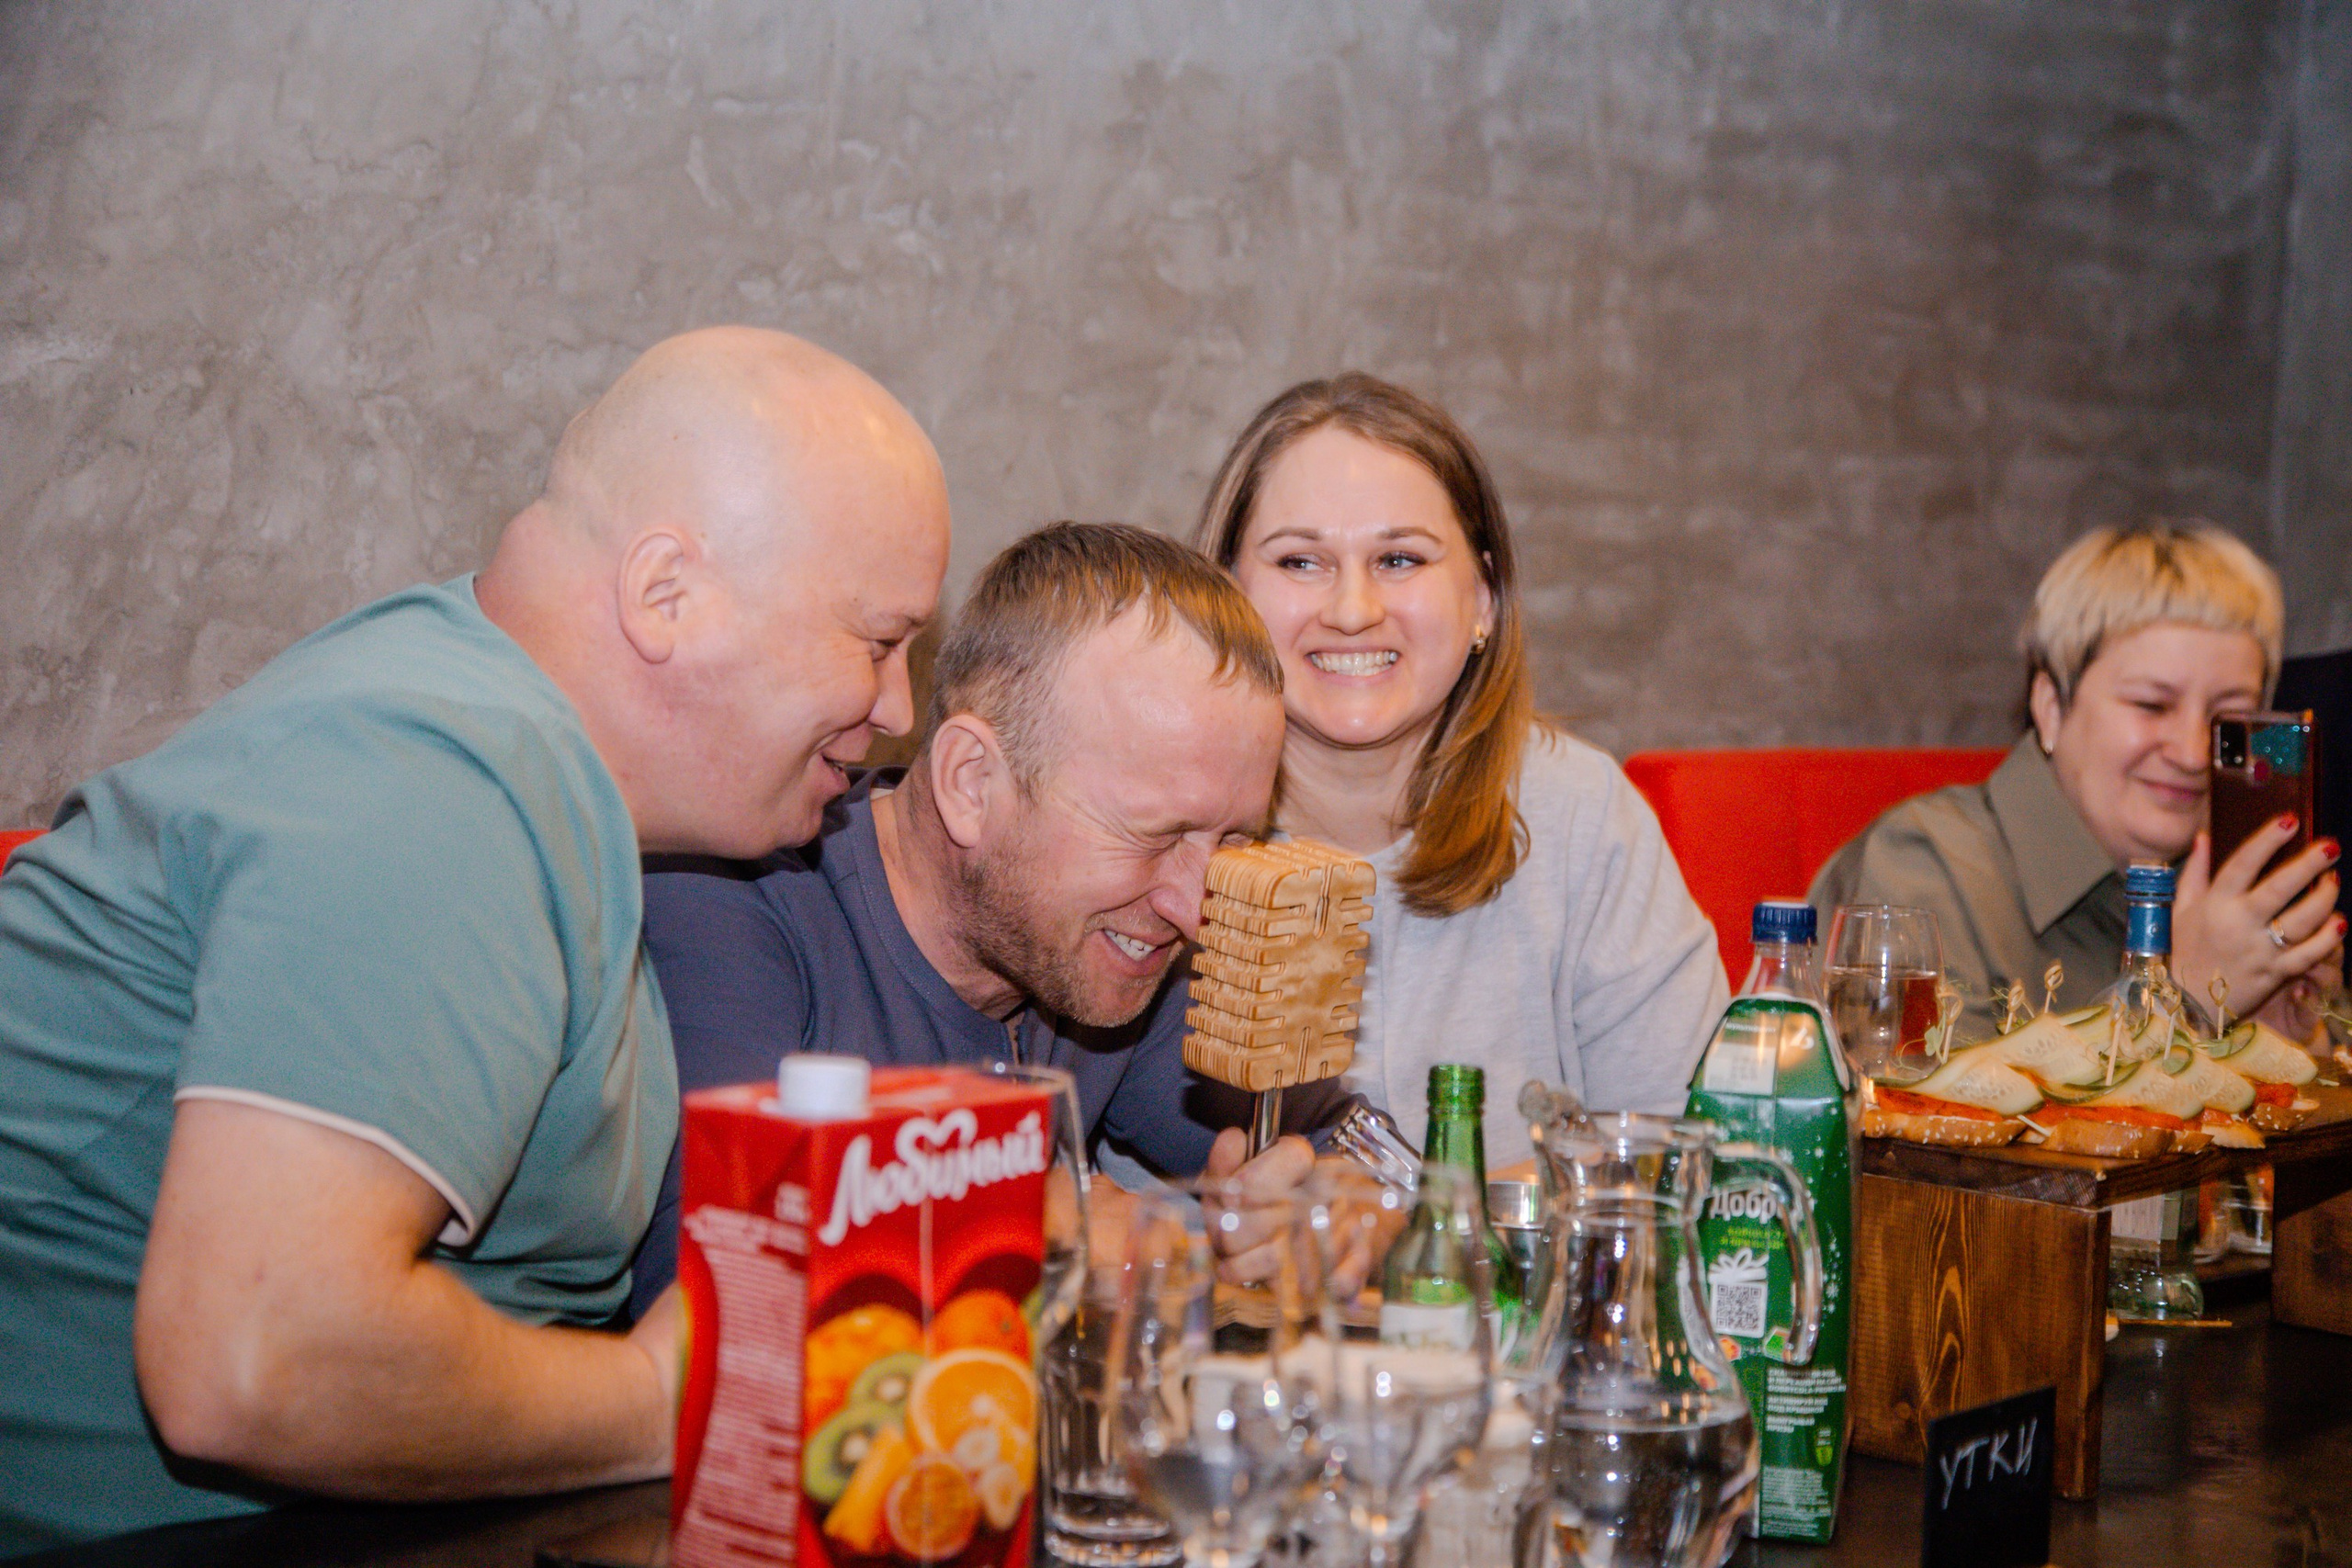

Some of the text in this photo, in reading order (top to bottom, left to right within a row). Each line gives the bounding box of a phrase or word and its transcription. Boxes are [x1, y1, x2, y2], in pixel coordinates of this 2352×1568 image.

[817, 1108, 1047, 1247] Любимый
[1710, 1186, 1792, 1224] Добр
[1939, 1416, 2038, 1511] УТКИ
